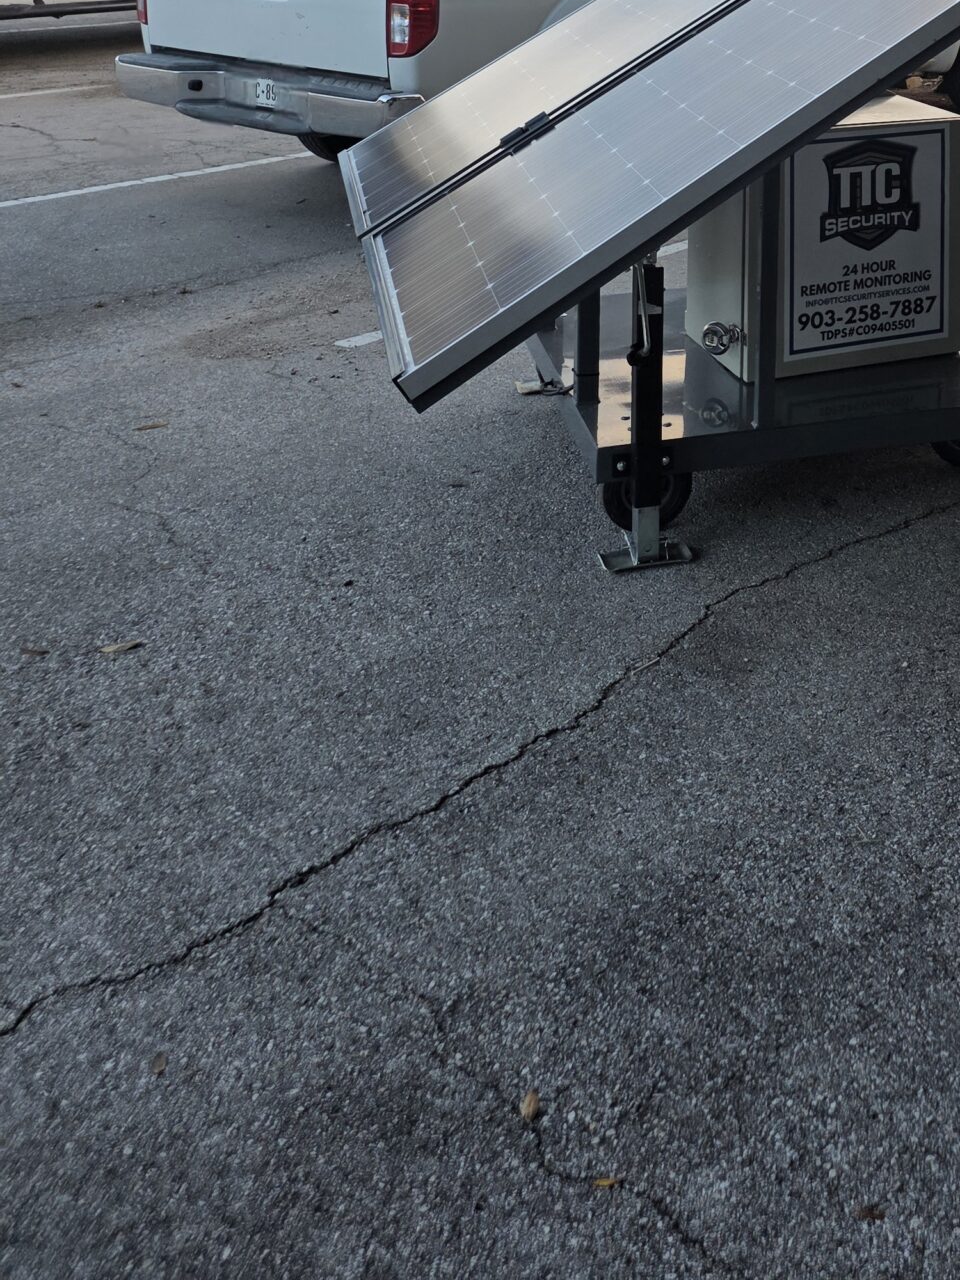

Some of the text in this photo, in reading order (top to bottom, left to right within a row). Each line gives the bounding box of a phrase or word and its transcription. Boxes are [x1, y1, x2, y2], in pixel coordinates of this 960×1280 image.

[833, 163, 900, 208] TTC
[825, 210, 912, 236] SECURITY
[842, 260, 896, 276] 24 HOUR
[801, 270, 932, 297] REMOTE MONITORING
[805, 285, 930, 308] INFO@TTCSECURITYSERVICES.COM
[798, 296, 937, 331] 903-258-7887
[820, 318, 915, 341] TDPS#C09405501
